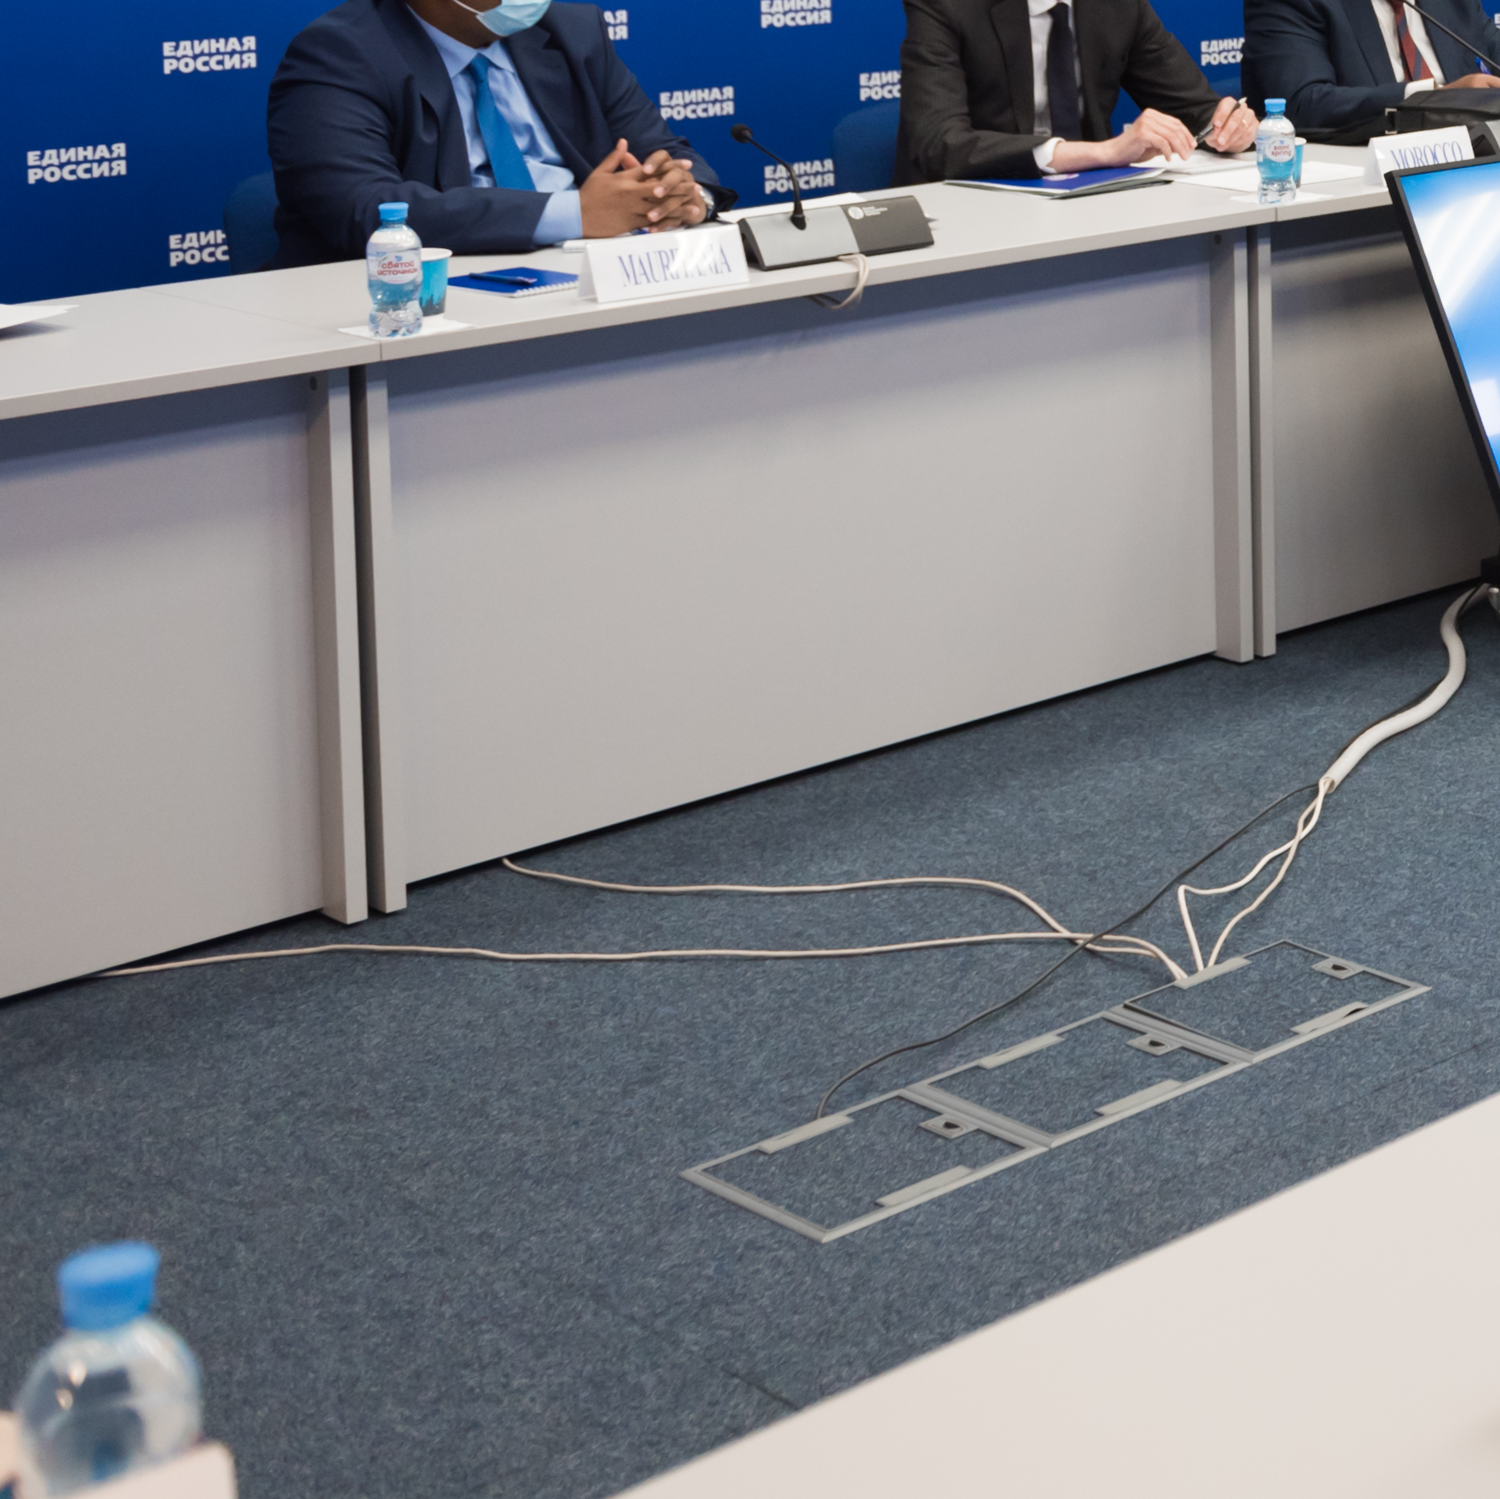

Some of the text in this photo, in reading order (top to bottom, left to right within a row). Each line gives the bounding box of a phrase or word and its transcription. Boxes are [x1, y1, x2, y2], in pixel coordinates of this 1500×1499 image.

[163, 36, 256, 57] ЕДИНАЯ
[164, 52, 256, 74] РОССИЯ
[27, 143, 126, 166] ЕДИНАЯ
[1390, 141, 1463, 169] MOROCCO
[28, 160, 126, 184] РОССИЯ
